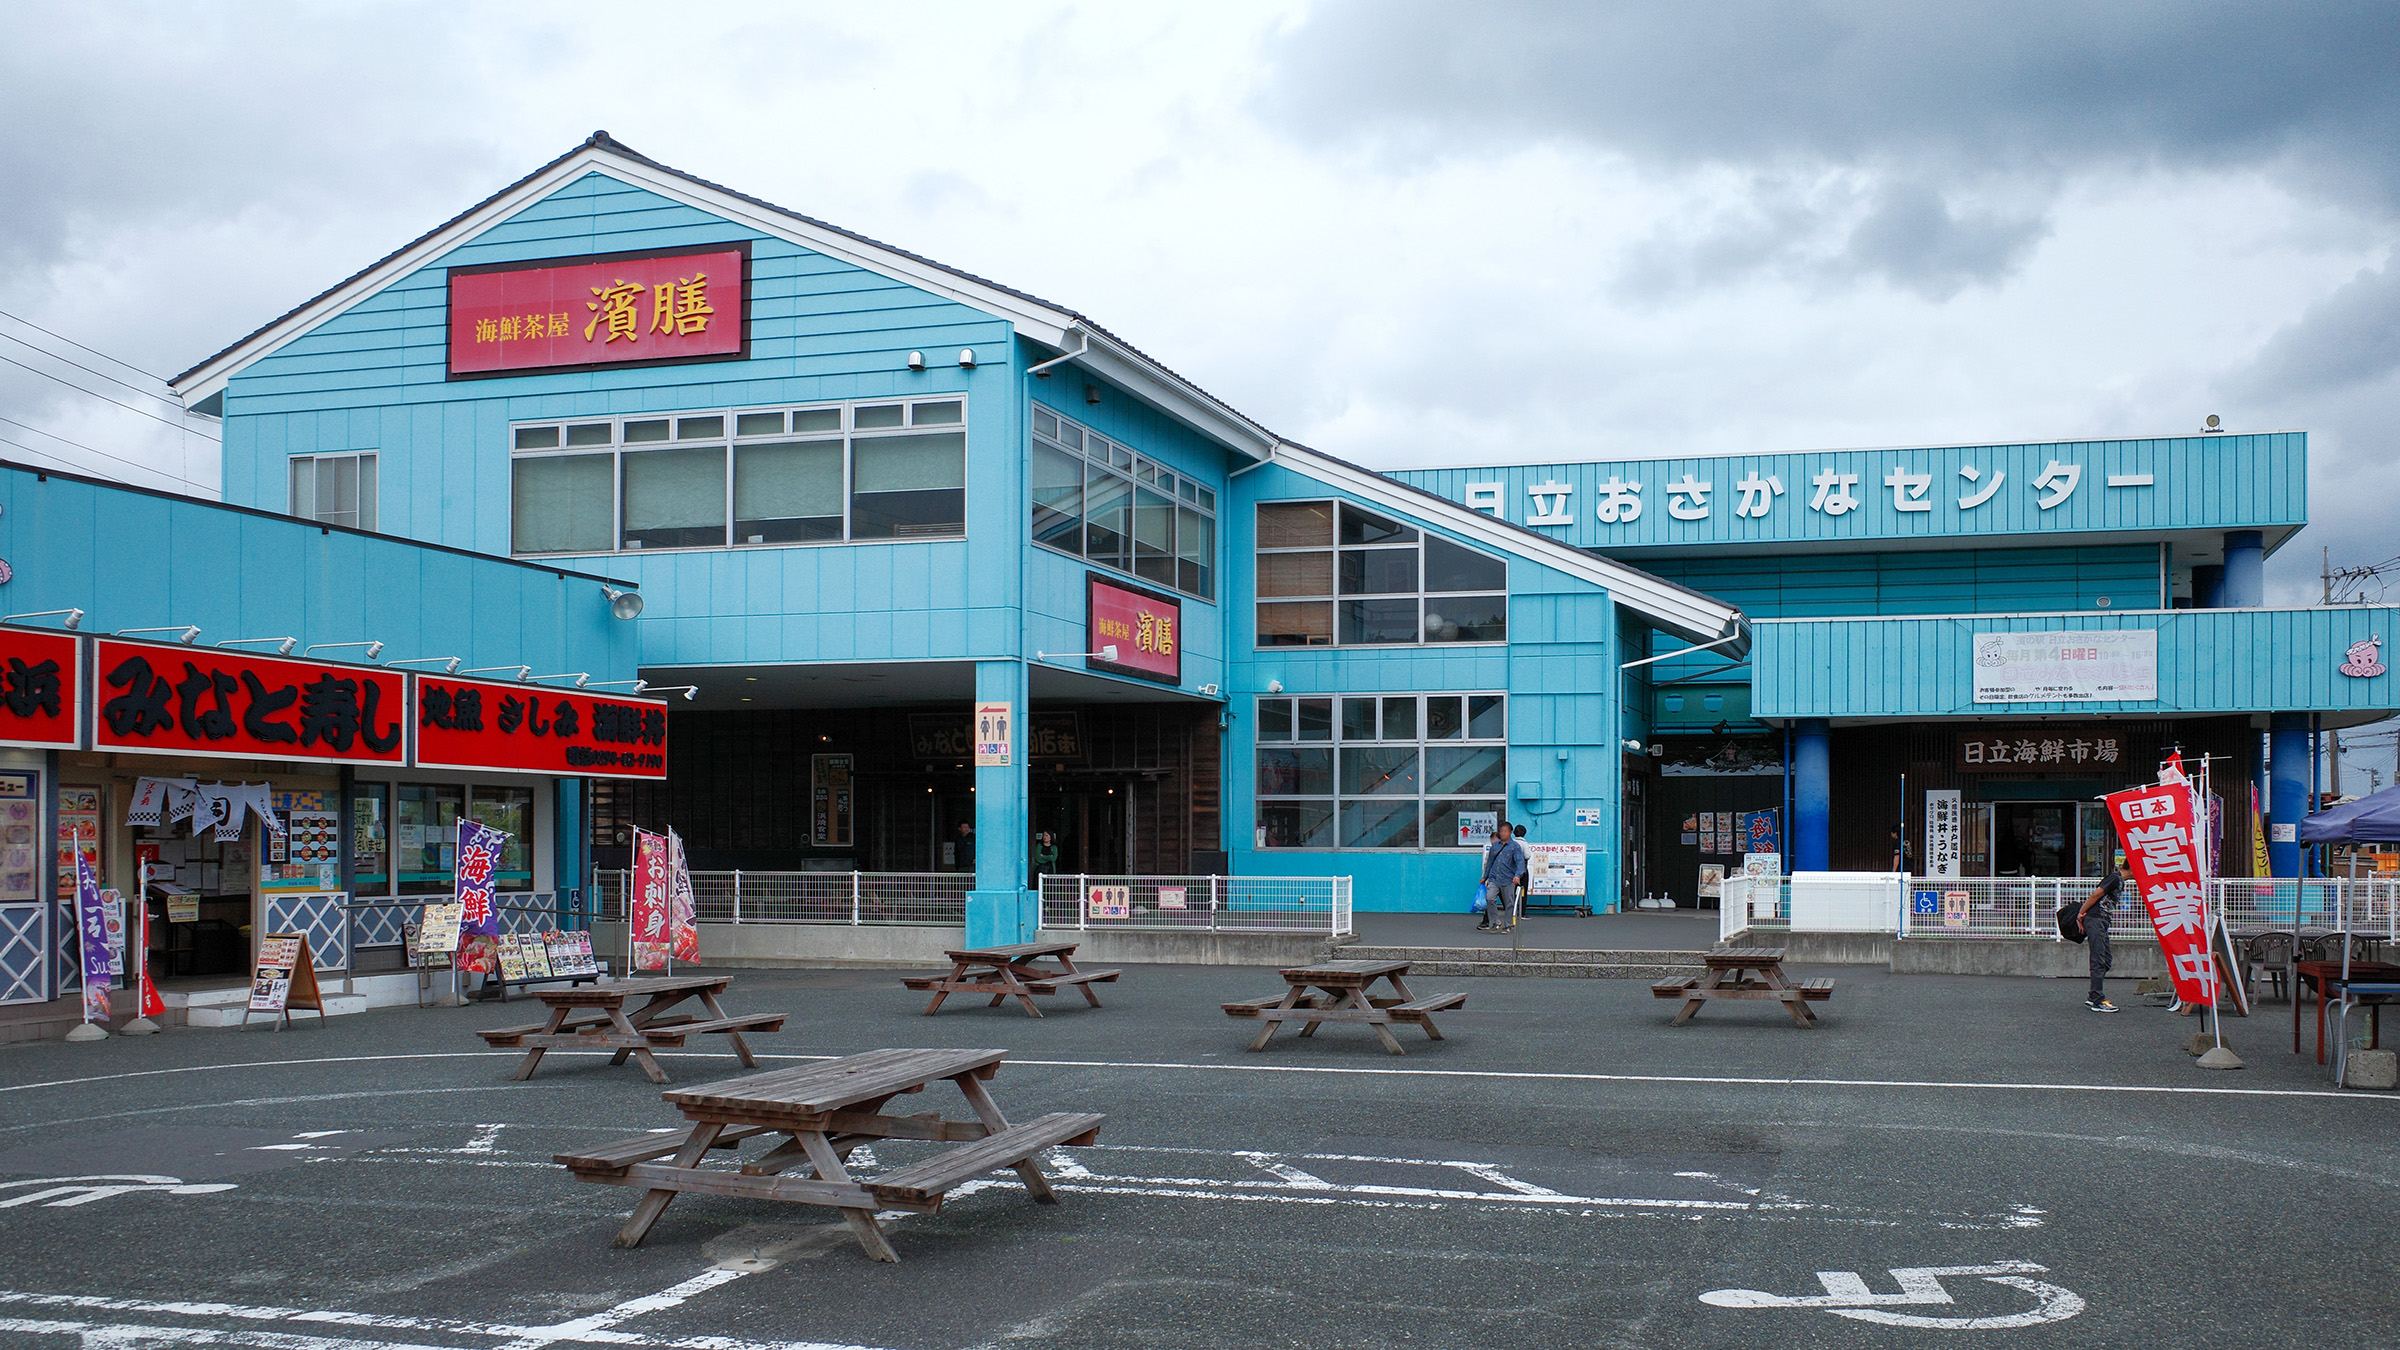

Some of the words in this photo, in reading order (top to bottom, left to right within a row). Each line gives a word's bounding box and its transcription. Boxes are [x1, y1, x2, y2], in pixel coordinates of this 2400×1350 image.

[475, 311, 570, 344] 海鮮茶屋
[583, 272, 714, 345] 濱膳
[1464, 460, 2154, 526] 日立おさかなセンター
[1098, 617, 1130, 641] 海鮮茶屋
[1134, 609, 1174, 656] 濱膳
[2007, 649, 2032, 662] 毎月
[2049, 634, 2137, 645] 日立おさかなセンター
[0, 656, 62, 719] 浜
[103, 655, 401, 753] みなと寿し
[421, 684, 484, 733] 地魚
[498, 693, 580, 738] さしみ
[592, 702, 666, 747] 海鮮丼
[1963, 738, 2120, 765] 日立海鮮市場
[1936, 799, 1949, 875] 海鮮丼・うなぎ
[2128, 798, 2169, 821] 日本
[458, 844, 494, 928] 海鮮
[643, 853, 667, 939] お刺身
[2126, 822, 2220, 998] 営業中
